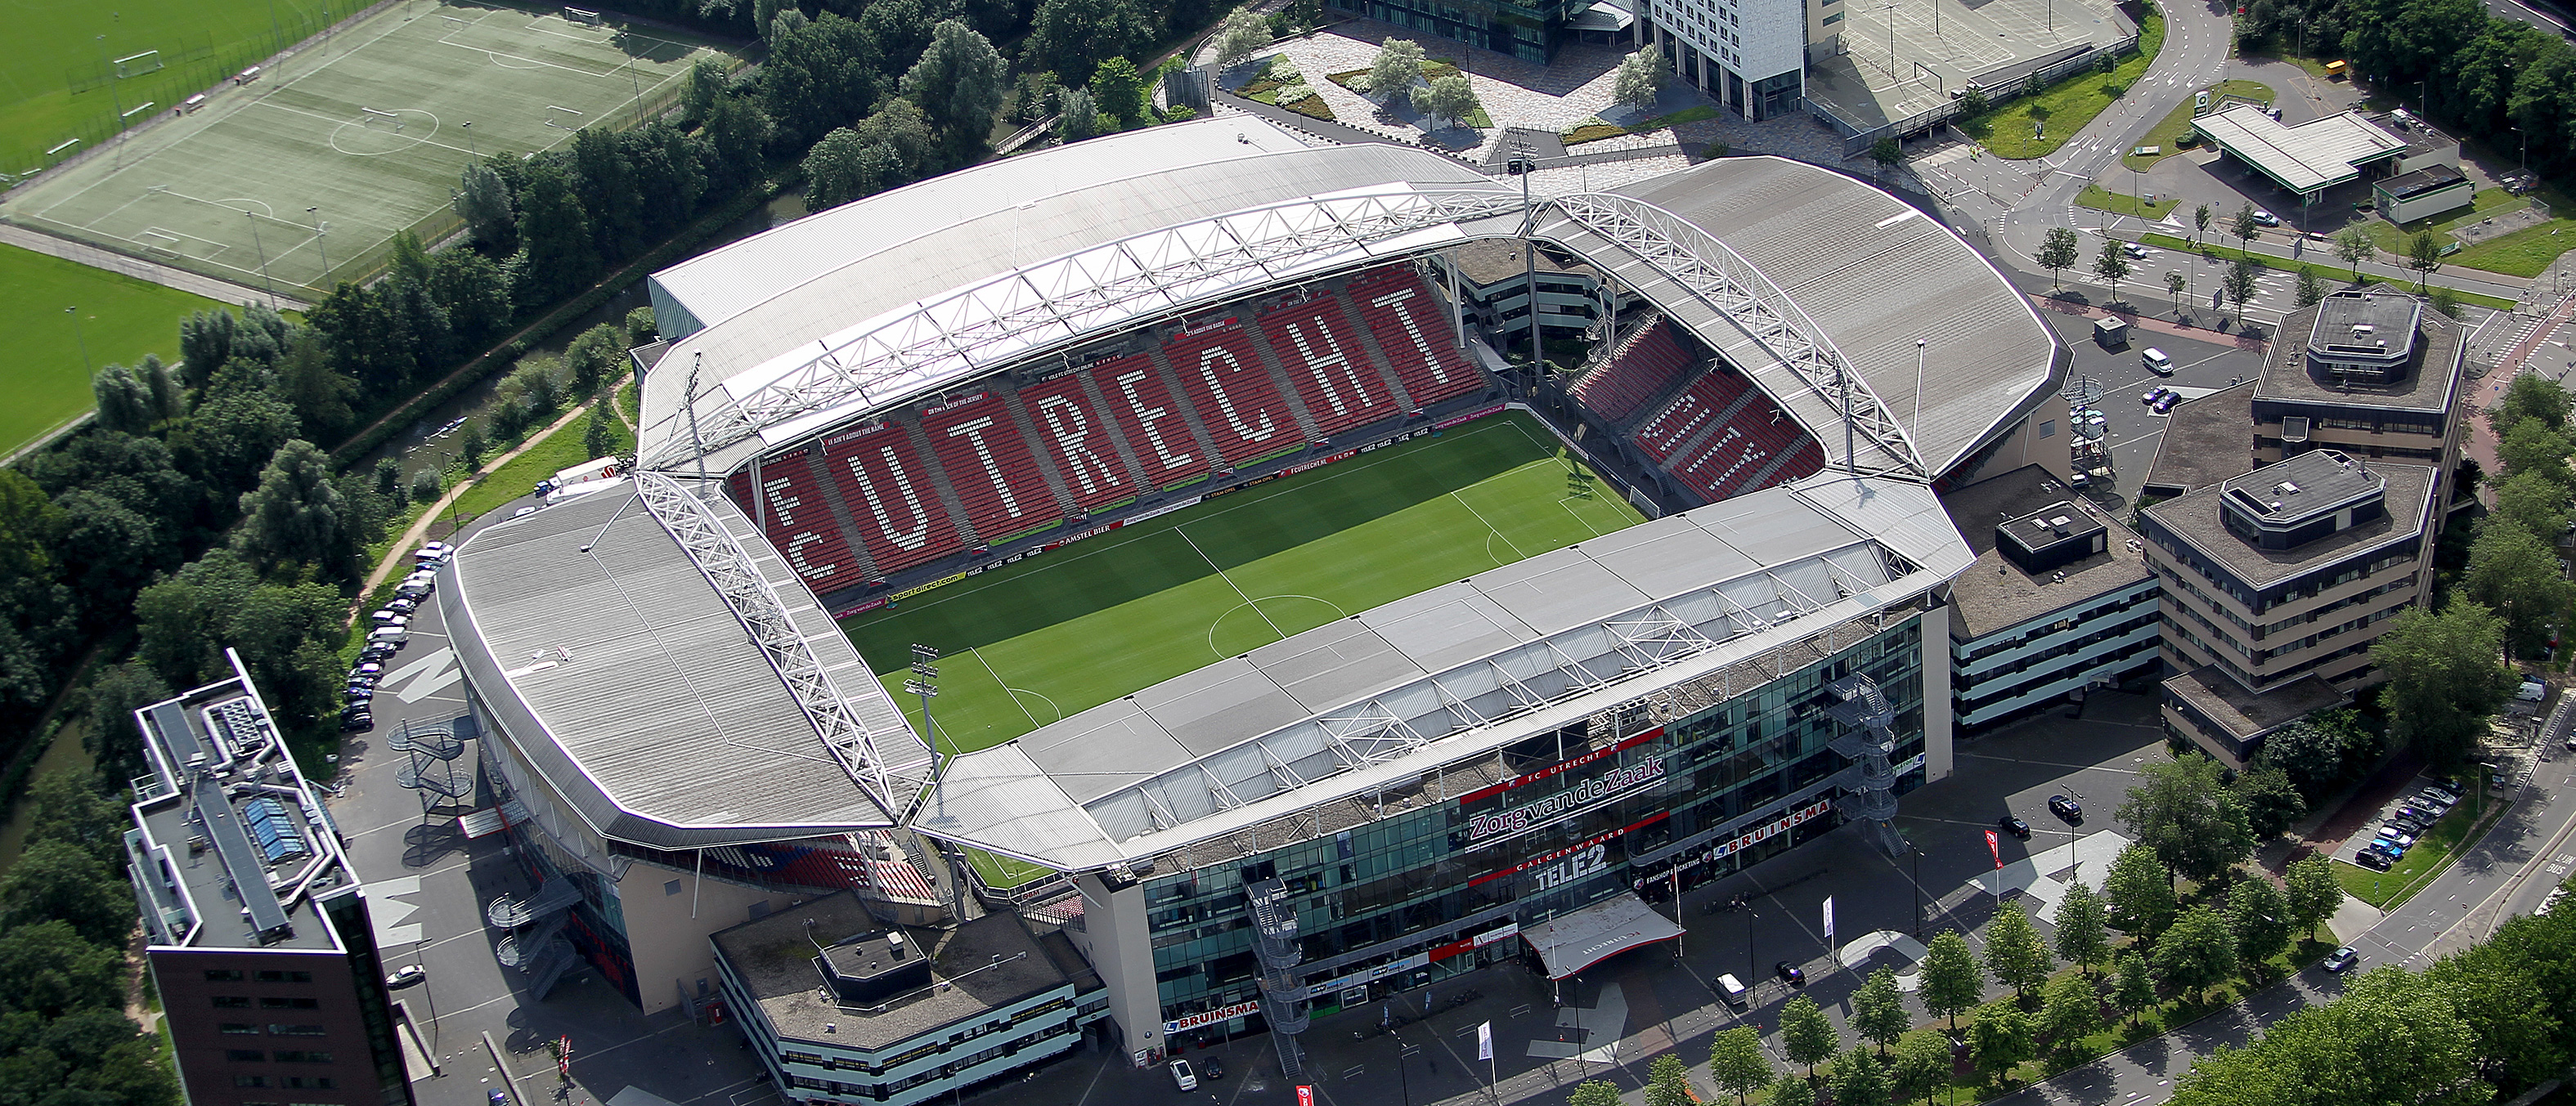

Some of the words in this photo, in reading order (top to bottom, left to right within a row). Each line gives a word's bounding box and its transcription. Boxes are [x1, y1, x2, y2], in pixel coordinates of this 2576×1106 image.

[847, 288, 1450, 551] UTRECHT
[1066, 531, 1093, 544] AMSTEL
[1093, 525, 1111, 536] BIER
[1528, 772, 1541, 781] FC
[1551, 752, 1600, 774] UTRECHT
[1470, 807, 1528, 840] Zorg
[1604, 755, 1665, 794] Zaak
[1728, 799, 1829, 853] BRUINSMA
[1516, 828, 1625, 871] GALGENWAARD
[1535, 844, 1607, 891] TELE2
[1647, 870, 1671, 884] FANSHOP
[1675, 858, 1699, 872] ICKETING
[2546, 863, 2566, 875] BUS
[1582, 935, 1627, 956] UTRECHT
[1179, 1001, 1259, 1029] BRUINSMA
